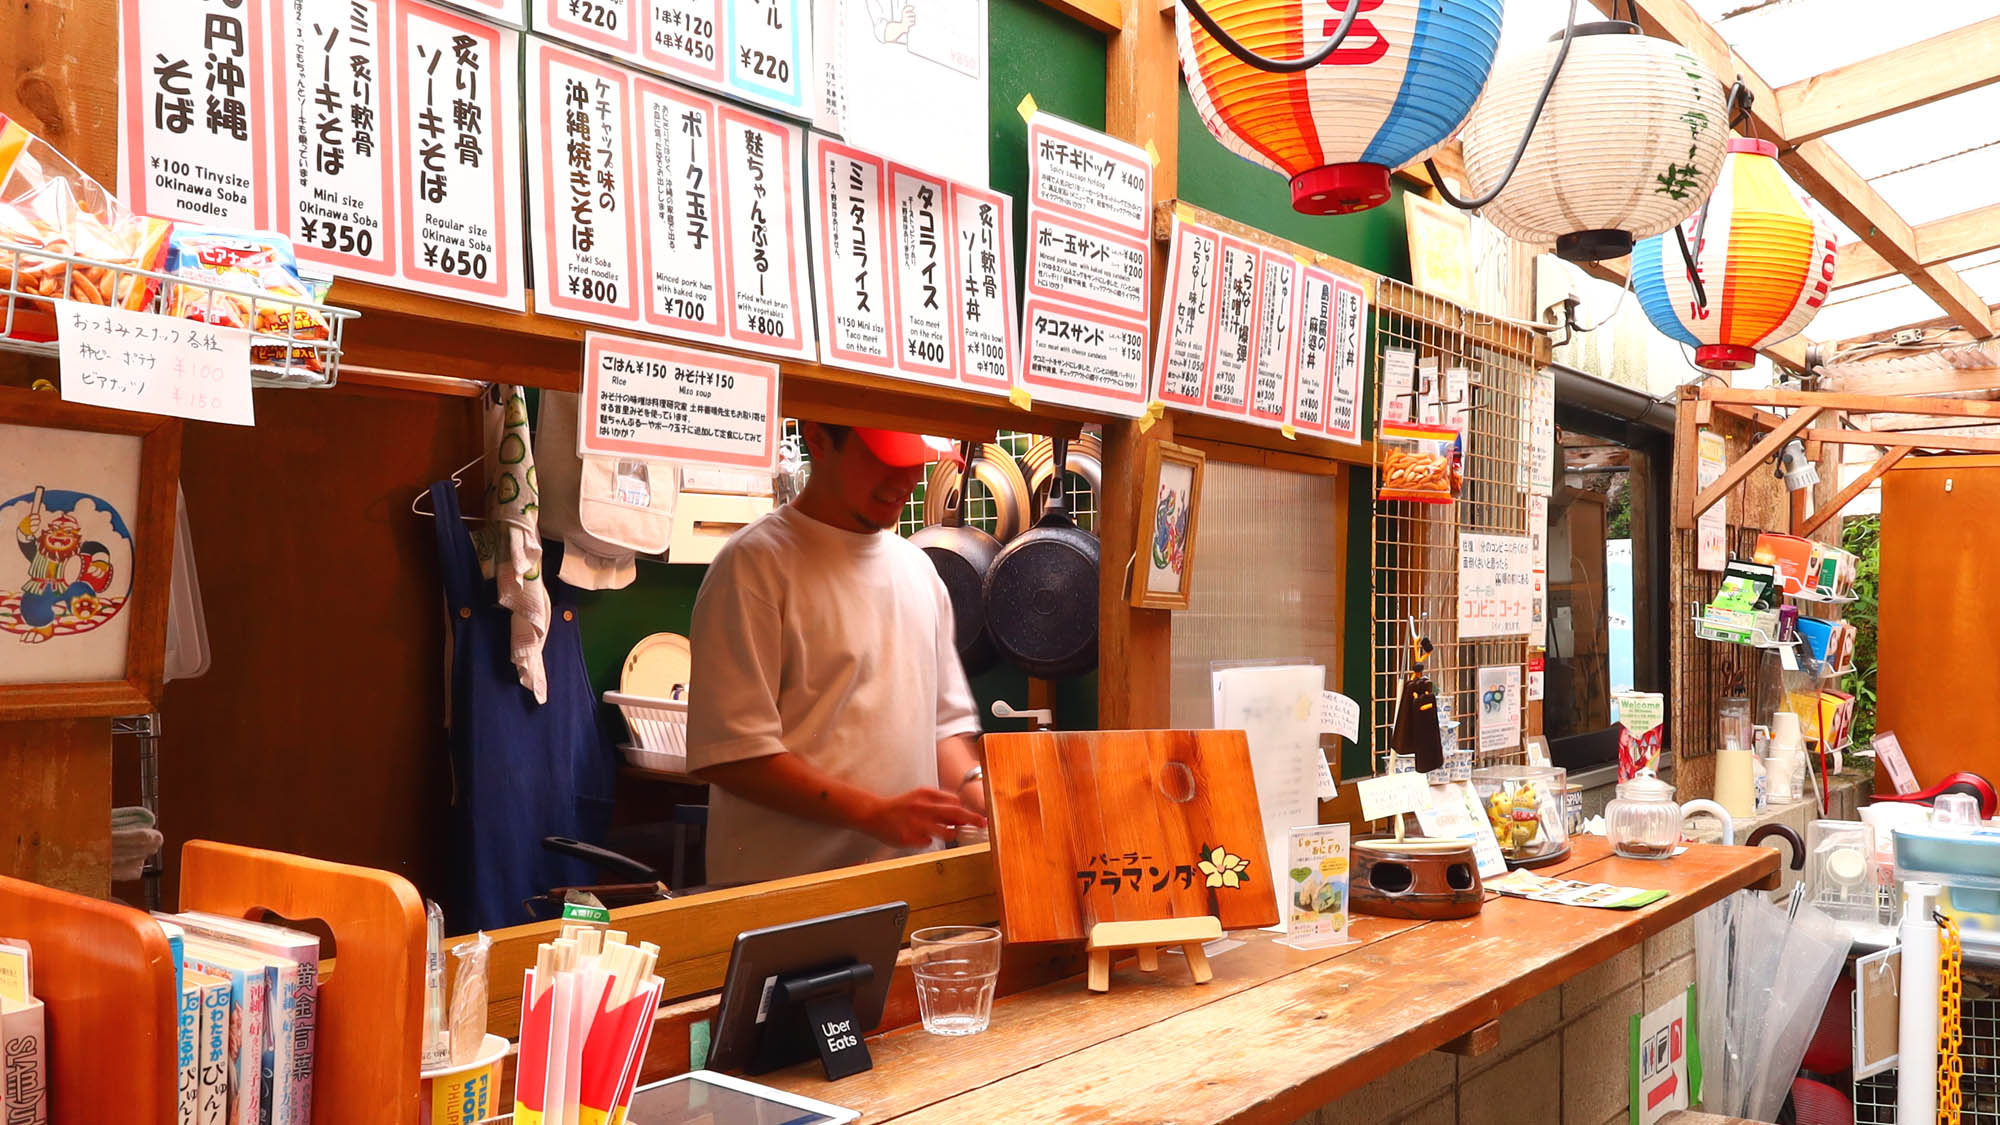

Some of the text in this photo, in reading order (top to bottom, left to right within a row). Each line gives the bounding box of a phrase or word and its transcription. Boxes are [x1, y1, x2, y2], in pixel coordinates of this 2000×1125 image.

[569, 0, 617, 31] ¥220
[655, 7, 713, 39] 1串¥120
[655, 31, 714, 62] 4串¥450
[203, 0, 248, 142] 円沖縄
[740, 45, 789, 84] ¥220
[154, 53, 194, 134] そば
[313, 23, 344, 176] ソーキそば
[452, 34, 483, 169] 炙り軟骨
[417, 44, 448, 204] ソーキそば
[595, 78, 616, 213] ケチャップ味の
[151, 156, 250, 188] ¥100 Tinysize
[565, 78, 595, 252] 沖縄焼きそば
[681, 109, 709, 251] ポーク玉子
[155, 175, 247, 205] Okinawa Soba
[1121, 171, 1144, 191] ¥400
[177, 199, 228, 217] noodles
[313, 187, 364, 209] Mini size
[744, 129, 769, 296] 麩ちゃんぷるー
[299, 200, 378, 228] Okinawa Soba
[425, 213, 487, 237] Regular size
[300, 216, 372, 257] ¥350
[422, 227, 492, 253] Okinawa Soba
[849, 161, 871, 313] ミニタコライス
[917, 185, 939, 310] タコライス
[979, 203, 996, 299] 炙り軟骨
[1039, 227, 1143, 265] ポー玉サンド ¥400
[423, 242, 487, 279] ¥650
[568, 263, 619, 281] Fried noodles
[576, 253, 612, 269] Yaki Soba
[1123, 263, 1143, 279] ¥200
[568, 275, 617, 304] ¥800
[656, 271, 713, 291] Minced pork ham
[963, 231, 980, 322] ソーキ丼
[1185, 237, 1201, 335] うちなー味噌汁
[1198, 239, 1212, 314] じゅーしーと
[656, 284, 707, 302] with baked egg
[737, 291, 789, 309] Fried wheat bran
[1229, 279, 1242, 335] 味噌汁
[664, 296, 705, 322] ¥700
[738, 303, 784, 319] with vegetables
[909, 315, 924, 326] Taco
[1175, 302, 1186, 338] セット
[1236, 255, 1254, 363] うちなー爆弾
[1277, 266, 1290, 351] じゅーしー
[1318, 284, 1330, 352] 島豆腐の
[73, 313, 180, 344] おつまみスナック
[187, 330, 223, 352] 各種
[748, 314, 784, 338] ¥800
[837, 316, 884, 333] ¥150 Mini size
[845, 329, 861, 339] Taco
[910, 328, 943, 340] on the rice
[1035, 316, 1142, 348] タコスサンド ¥300
[1346, 296, 1357, 368] もずく丼
[856, 343, 867, 352] the
[868, 346, 881, 355] rice
[908, 338, 944, 363] ¥400
[967, 341, 1004, 360] 大¥1000
[1121, 347, 1142, 362] ¥150
[1307, 317, 1318, 370] 麻婆丼
[174, 357, 224, 381] ¥100
[602, 356, 734, 390] ごはん¥150 みそ汁¥150
[612, 376, 627, 386] Rice
[977, 361, 1004, 376] 中¥700
[171, 387, 223, 409] ¥150
[679, 385, 712, 398] Miso soup
[1181, 384, 1199, 398] ¥650
[1621, 700, 1660, 709] Welcome
[1089, 851, 1153, 866] パーラー
[1077, 864, 1197, 897] アラマンダ
[293, 963, 317, 1081] 黄金言葉
[822, 1020, 851, 1038] Uber
[827, 1033, 857, 1052] Eats
